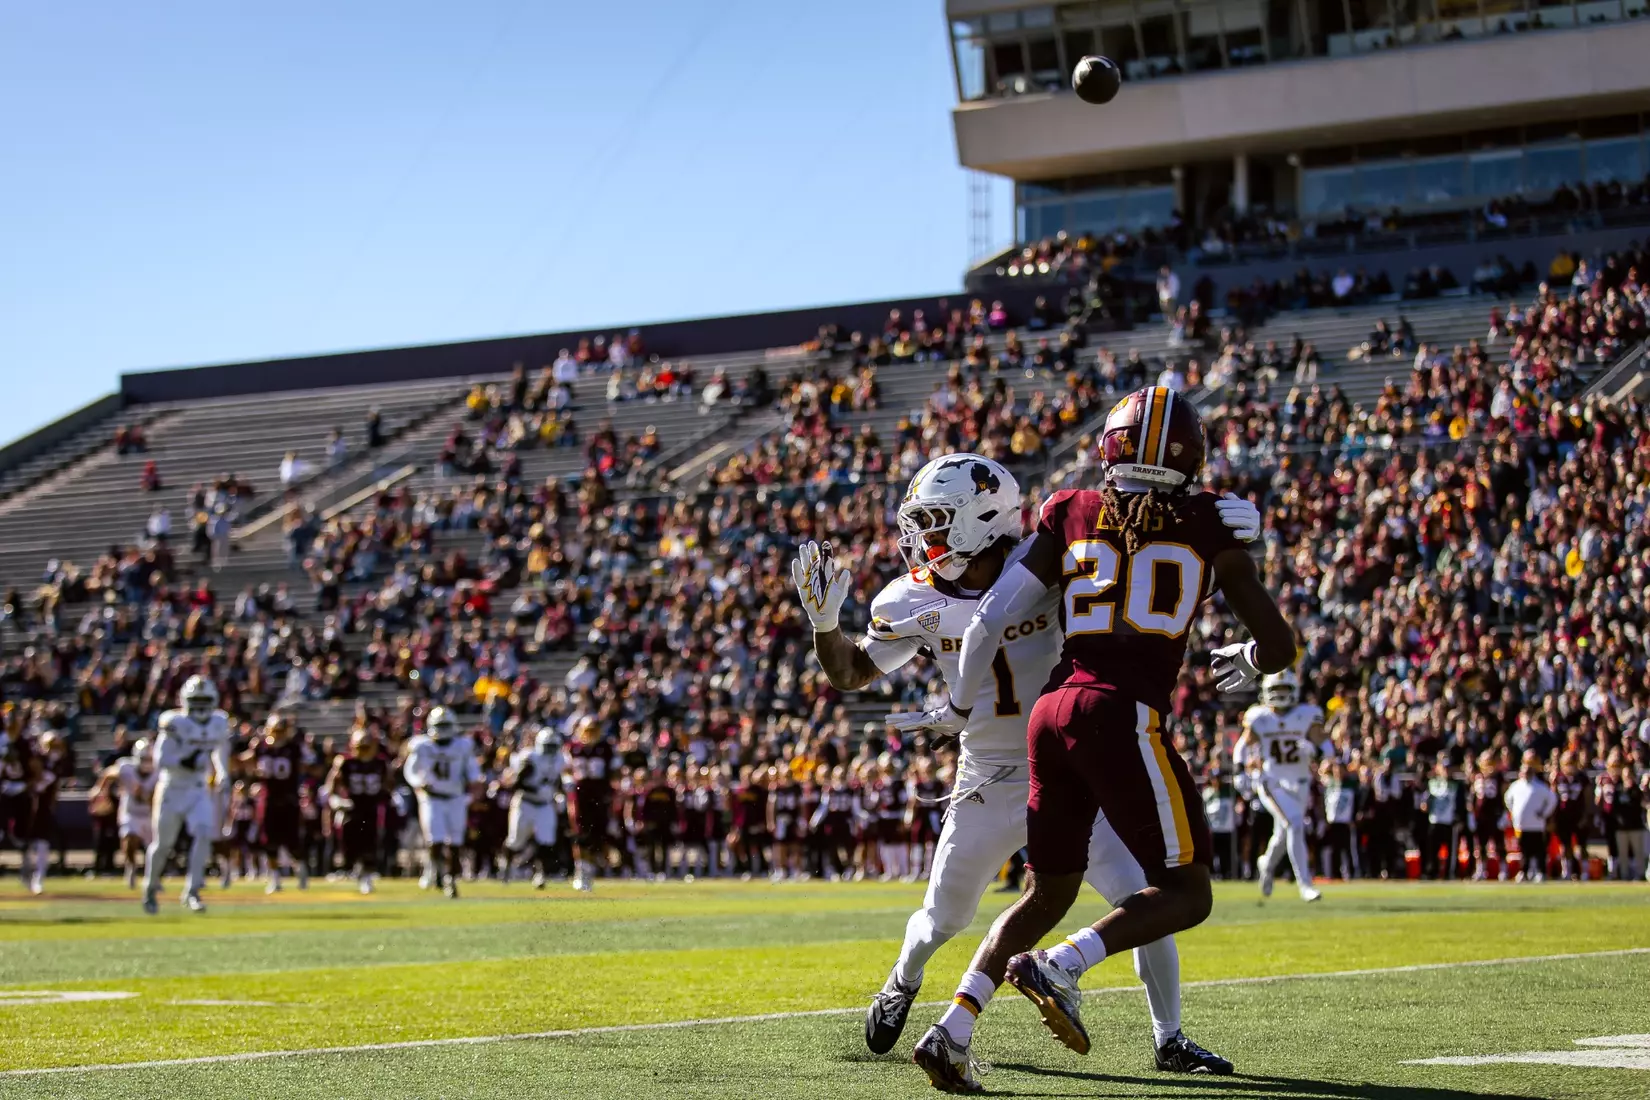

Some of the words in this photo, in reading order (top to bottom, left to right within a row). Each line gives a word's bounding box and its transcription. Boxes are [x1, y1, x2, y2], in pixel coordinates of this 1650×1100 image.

[1131, 465, 1167, 476] BRAVERY
[1061, 539, 1205, 640] 20
[991, 645, 1022, 717] 1
[1270, 739, 1300, 764] 42
